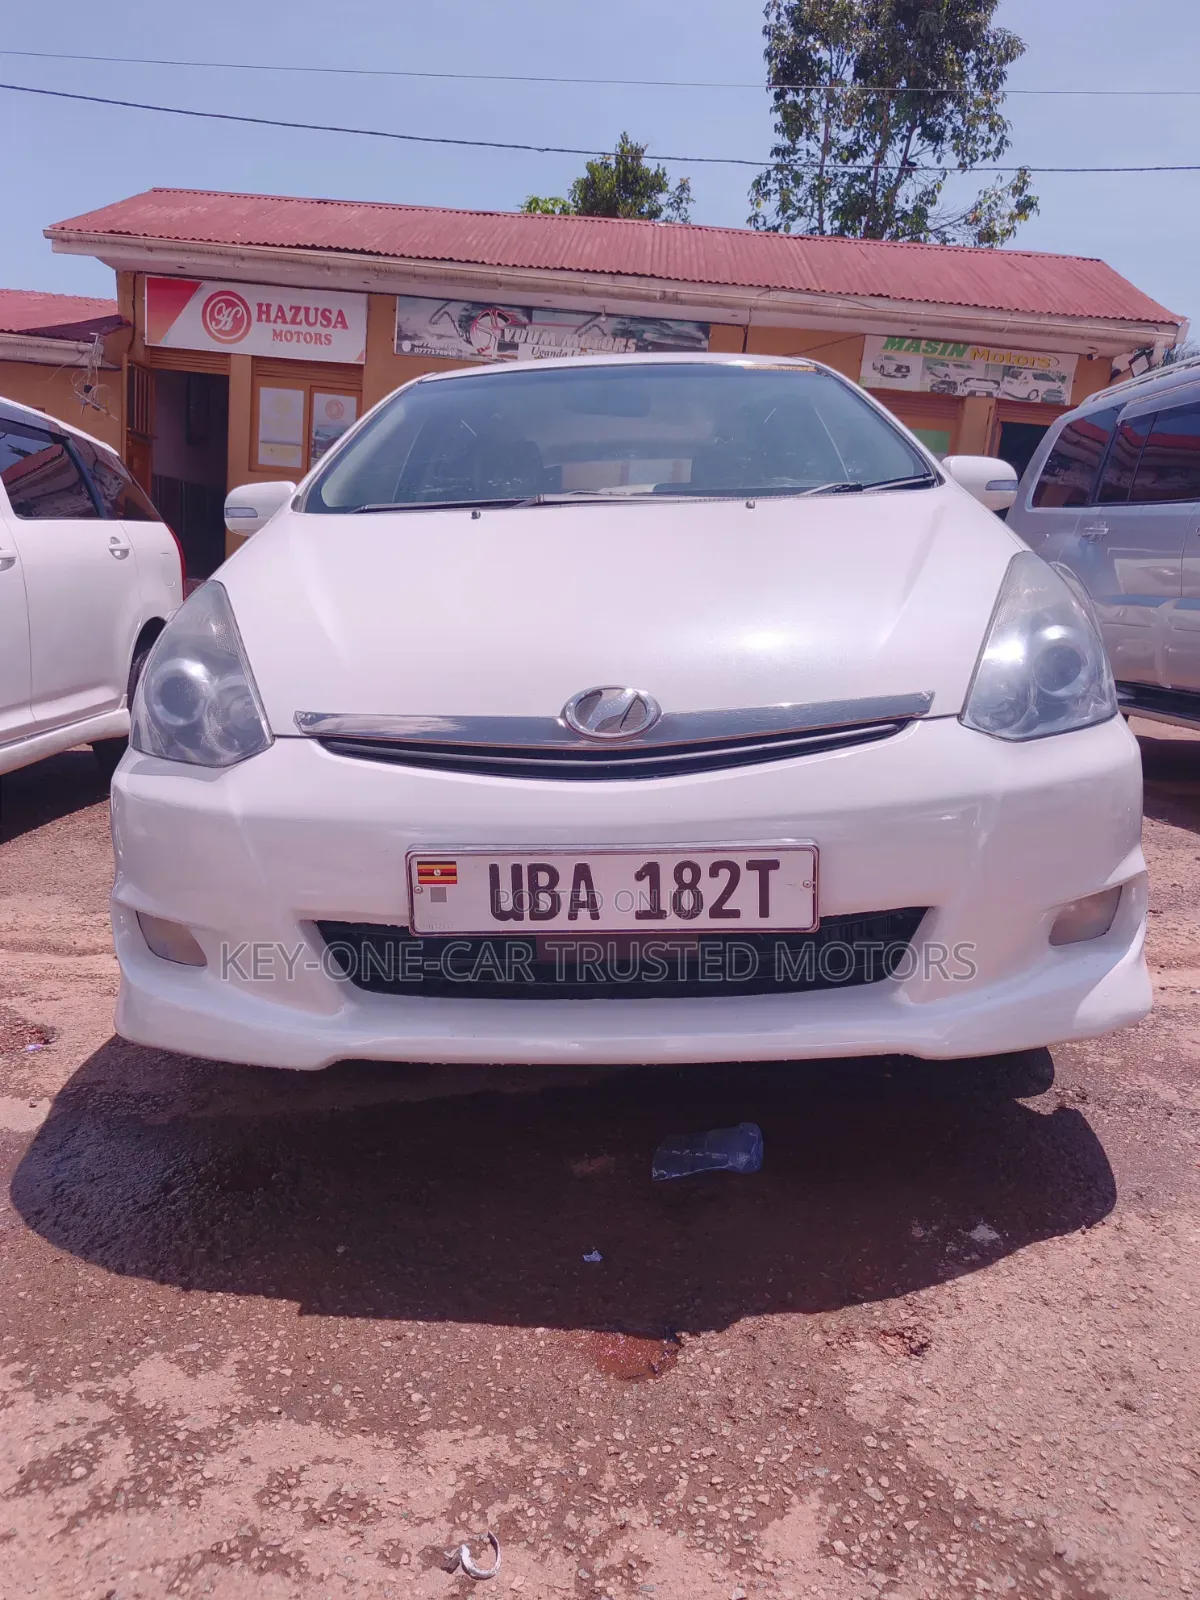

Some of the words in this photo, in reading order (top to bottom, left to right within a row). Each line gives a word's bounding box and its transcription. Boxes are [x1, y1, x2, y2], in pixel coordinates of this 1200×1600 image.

[256, 303, 349, 330] HAZUSA
[272, 329, 332, 346] MOTORS
[561, 333, 637, 353] MOTORS
[531, 346, 568, 360] Uganda
[882, 337, 970, 358] MASIN
[970, 347, 1054, 369] Motors
[488, 862, 601, 922] UBA
[634, 859, 781, 920] 182T
